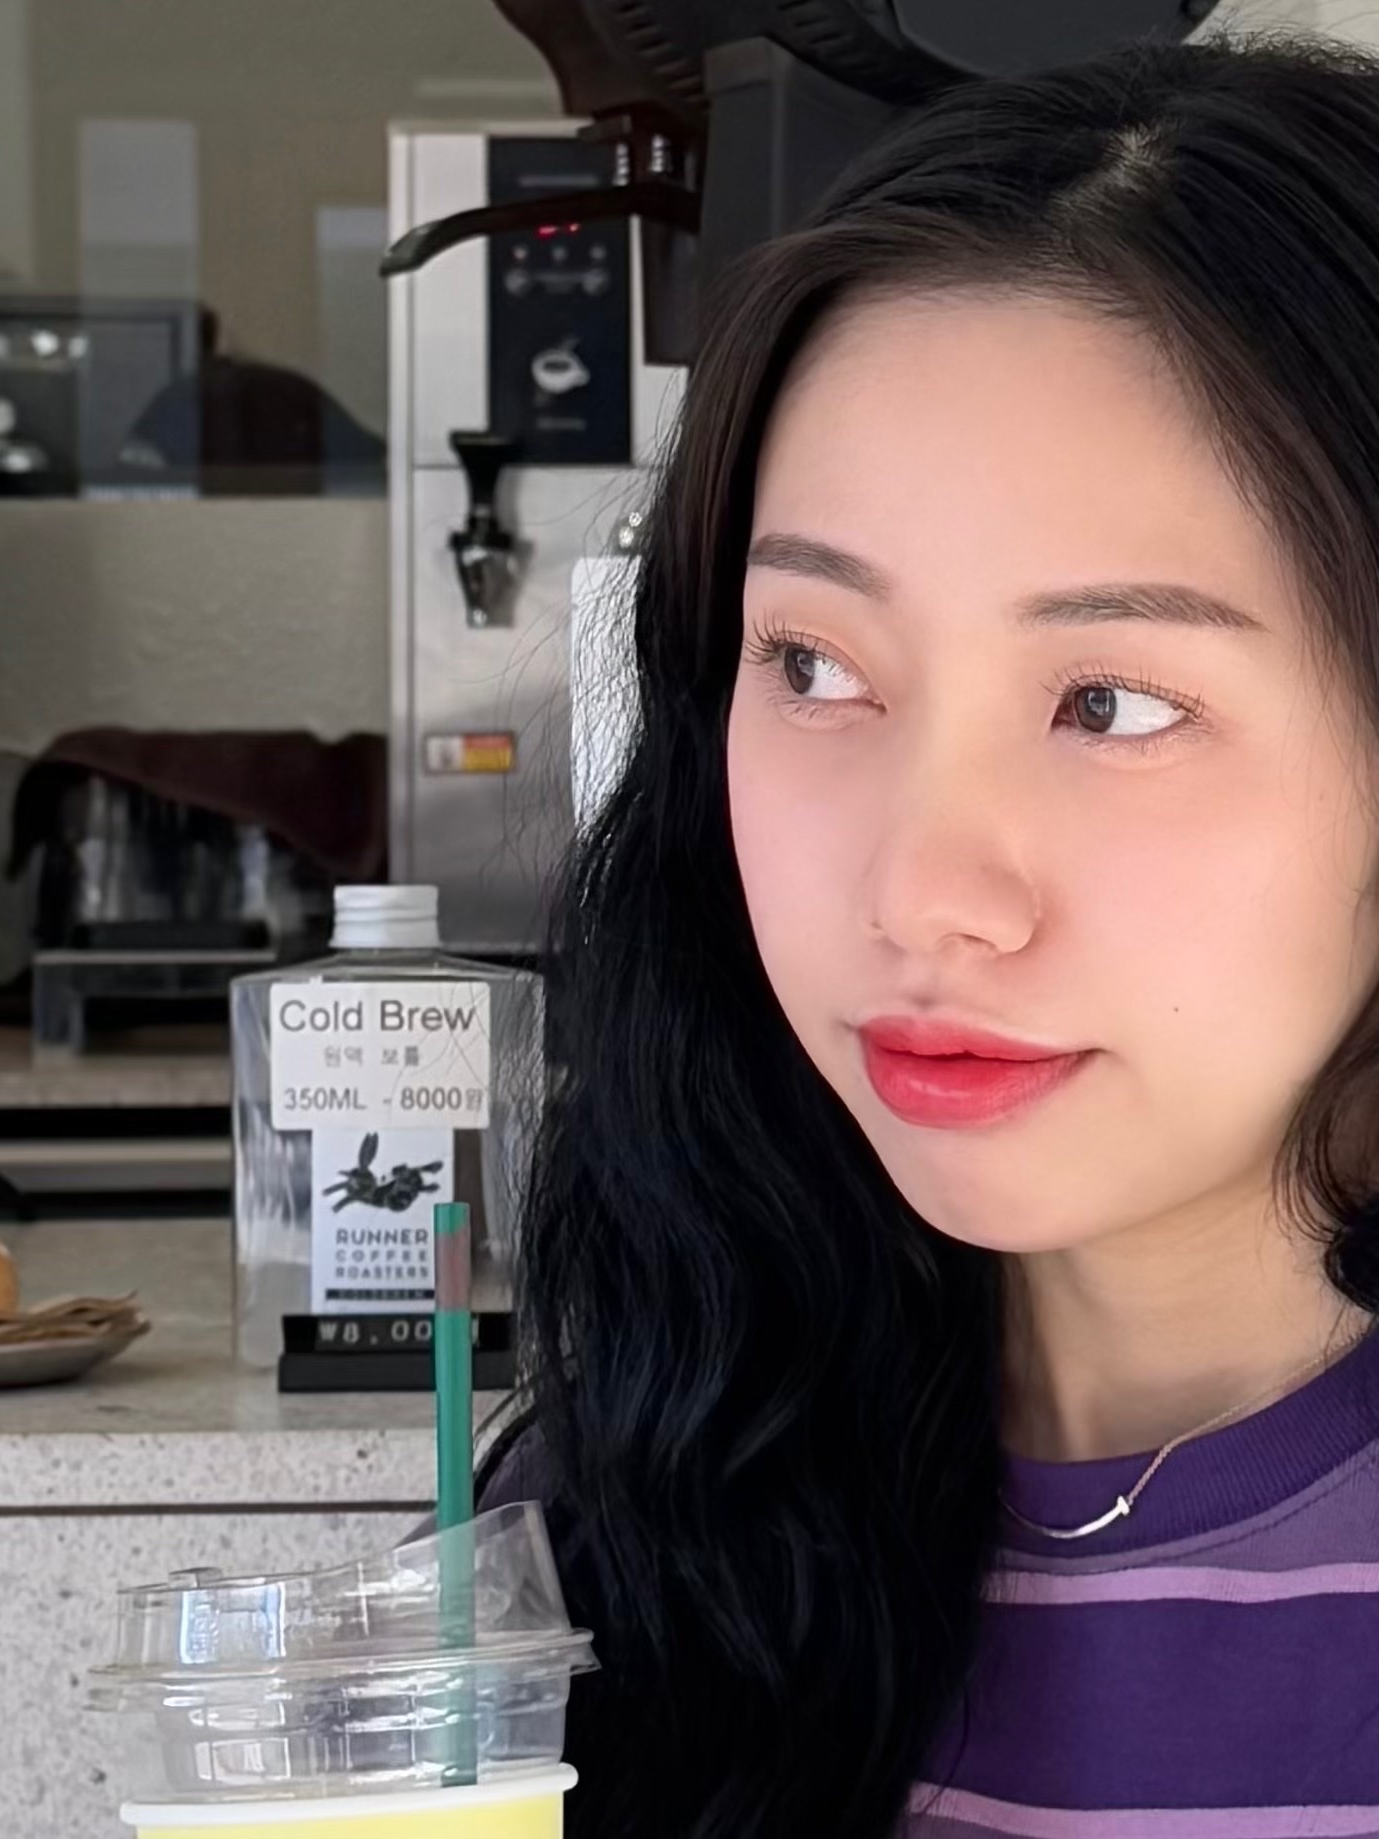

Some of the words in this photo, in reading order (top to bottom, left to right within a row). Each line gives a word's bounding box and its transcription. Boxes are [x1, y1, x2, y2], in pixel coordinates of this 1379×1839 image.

[279, 999, 364, 1033] Cold
[380, 998, 477, 1032] Brew
[283, 1086, 369, 1111] 350ML
[335, 1228, 430, 1246] RUNNER
[335, 1249, 427, 1262] COFFEE
[335, 1266, 430, 1280] ROASTERS
